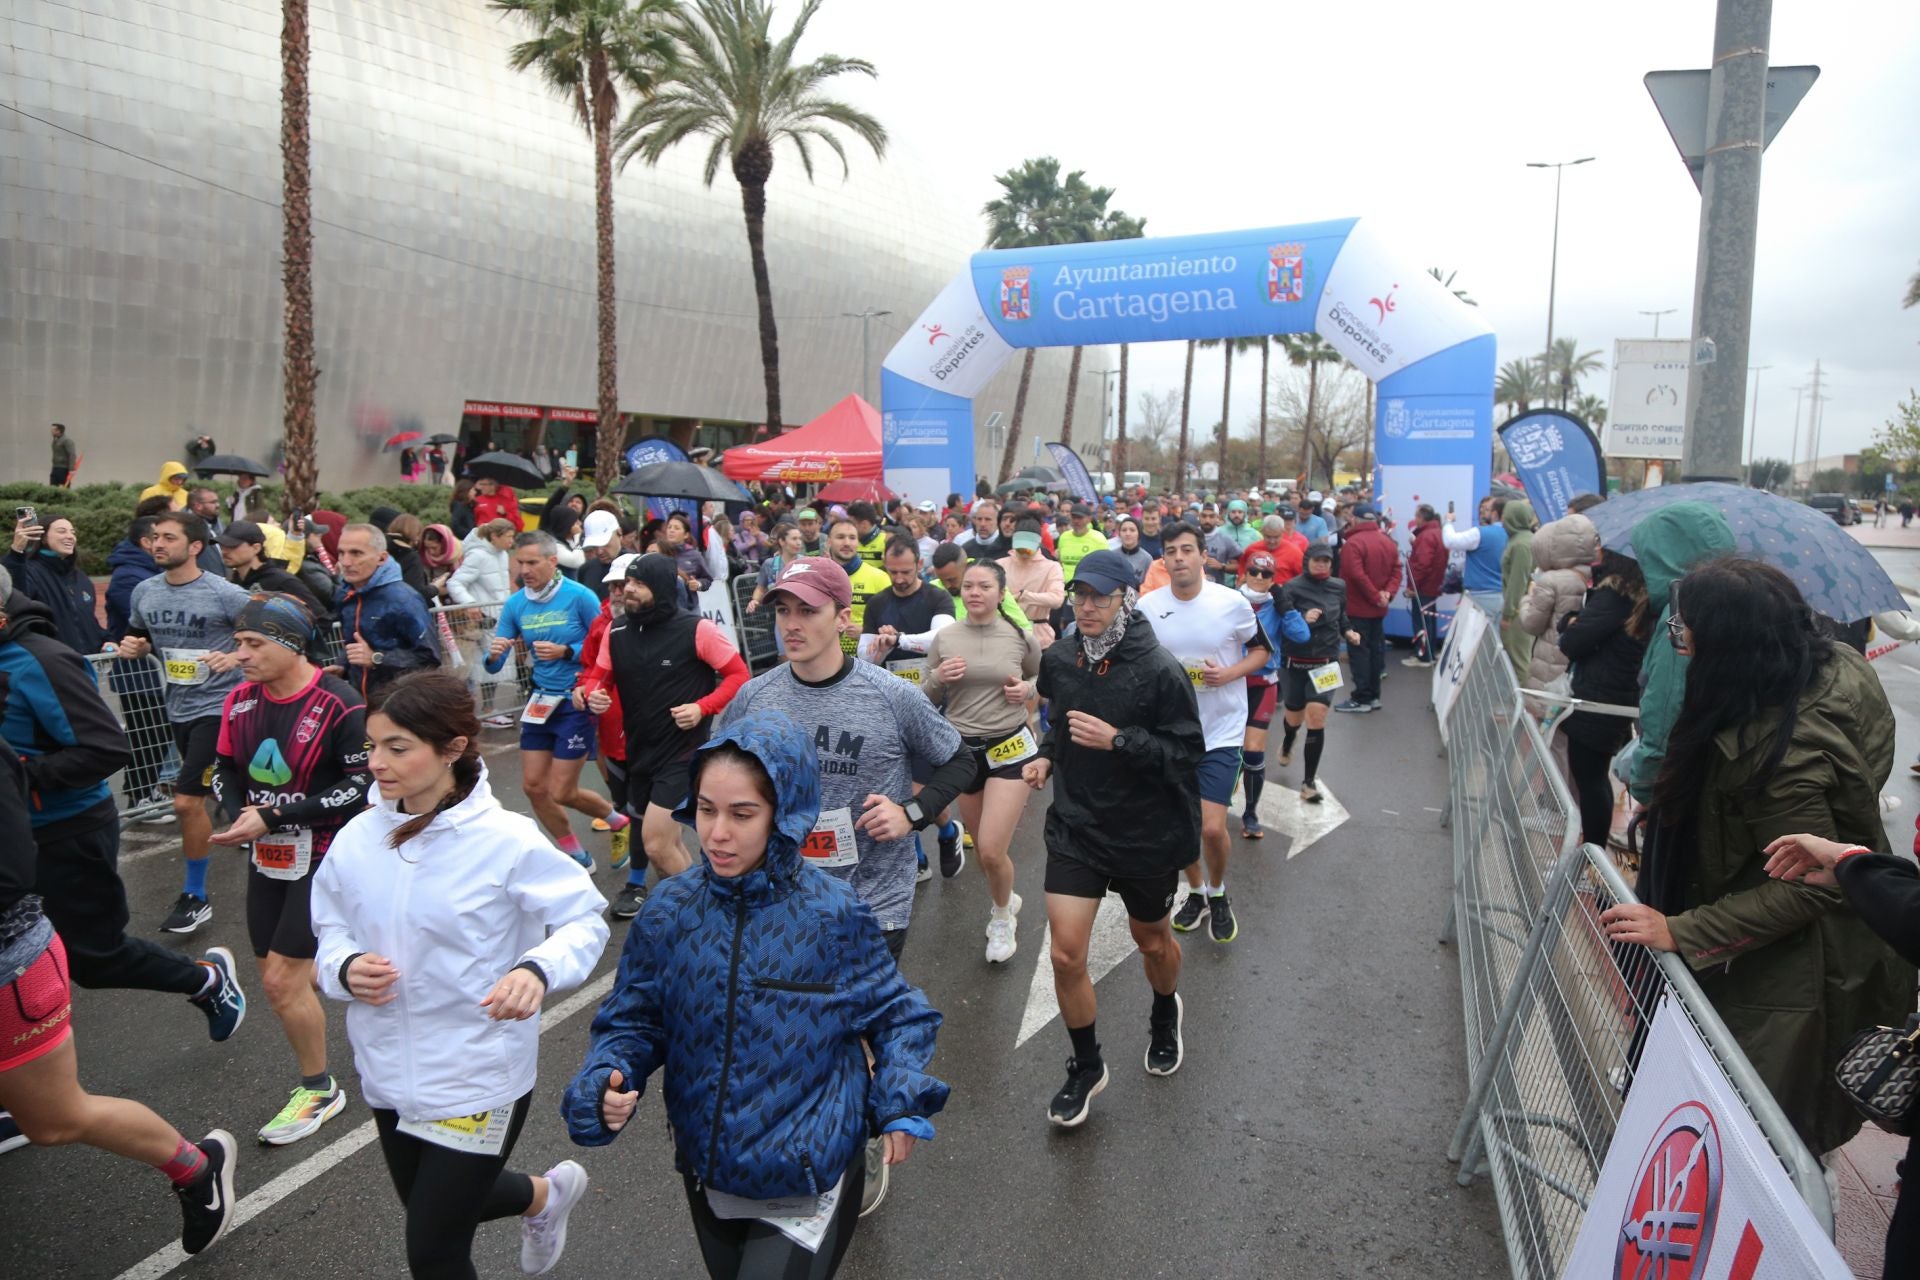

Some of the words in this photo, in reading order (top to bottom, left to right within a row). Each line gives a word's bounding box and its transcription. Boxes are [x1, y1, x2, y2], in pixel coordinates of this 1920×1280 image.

[1053, 255, 1237, 290] Ayuntamiento
[1053, 286, 1238, 323] Cartagena
[965, 325, 976, 336] de
[1328, 308, 1388, 364] Deportes
[935, 330, 984, 380] Deportes
[1380, 342, 1394, 355] de
[503, 407, 540, 416] GENERAL
[552, 409, 585, 419] ENTRADA
[1412, 417, 1474, 429] Cartagena
[148, 610, 208, 630] UCAM
[814, 725, 865, 760] AM
[994, 738, 1025, 758] 2415
[800, 836, 835, 851] 12
[260, 848, 294, 862] 1025
